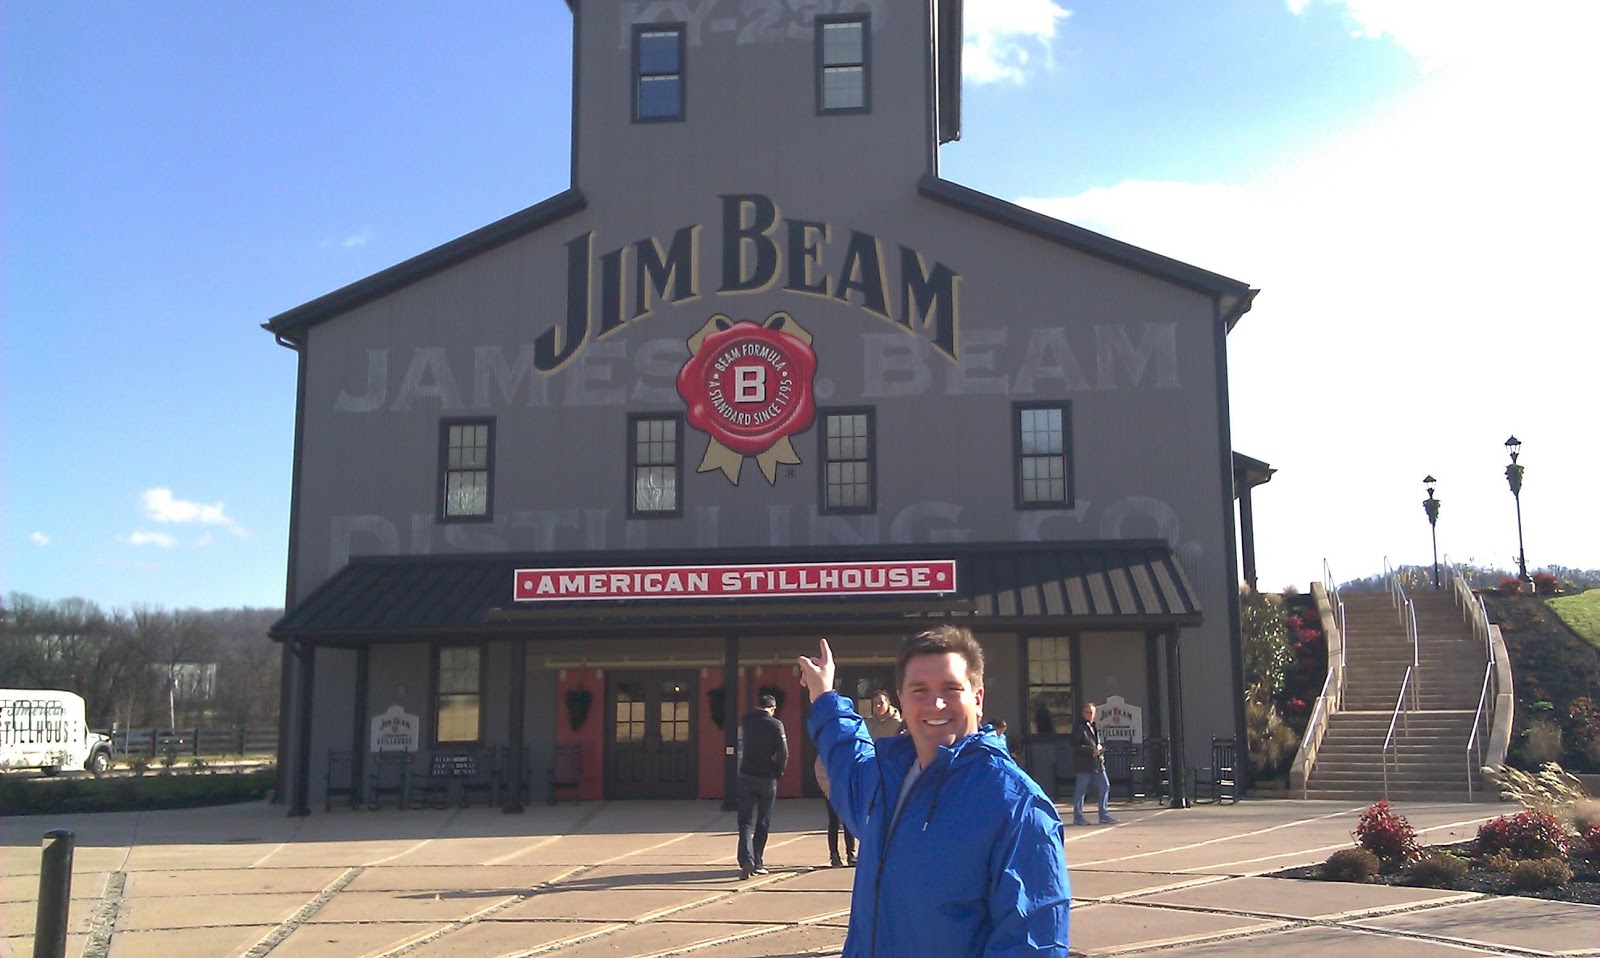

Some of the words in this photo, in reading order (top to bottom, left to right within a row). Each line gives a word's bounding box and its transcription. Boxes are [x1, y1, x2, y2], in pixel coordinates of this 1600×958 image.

[534, 225, 702, 376] JIM
[716, 193, 962, 364] BEAM
[333, 338, 686, 412] JAMES
[714, 348, 742, 372] BEAM
[742, 344, 786, 371] FORMULA
[861, 322, 1182, 398] BEAM
[709, 390, 751, 426] STANDARD
[753, 404, 782, 425] SINCE
[774, 378, 793, 406] 1795
[734, 365, 768, 403] B
[536, 572, 710, 595] AMERICAN
[721, 567, 931, 592] STILLHOUSE
